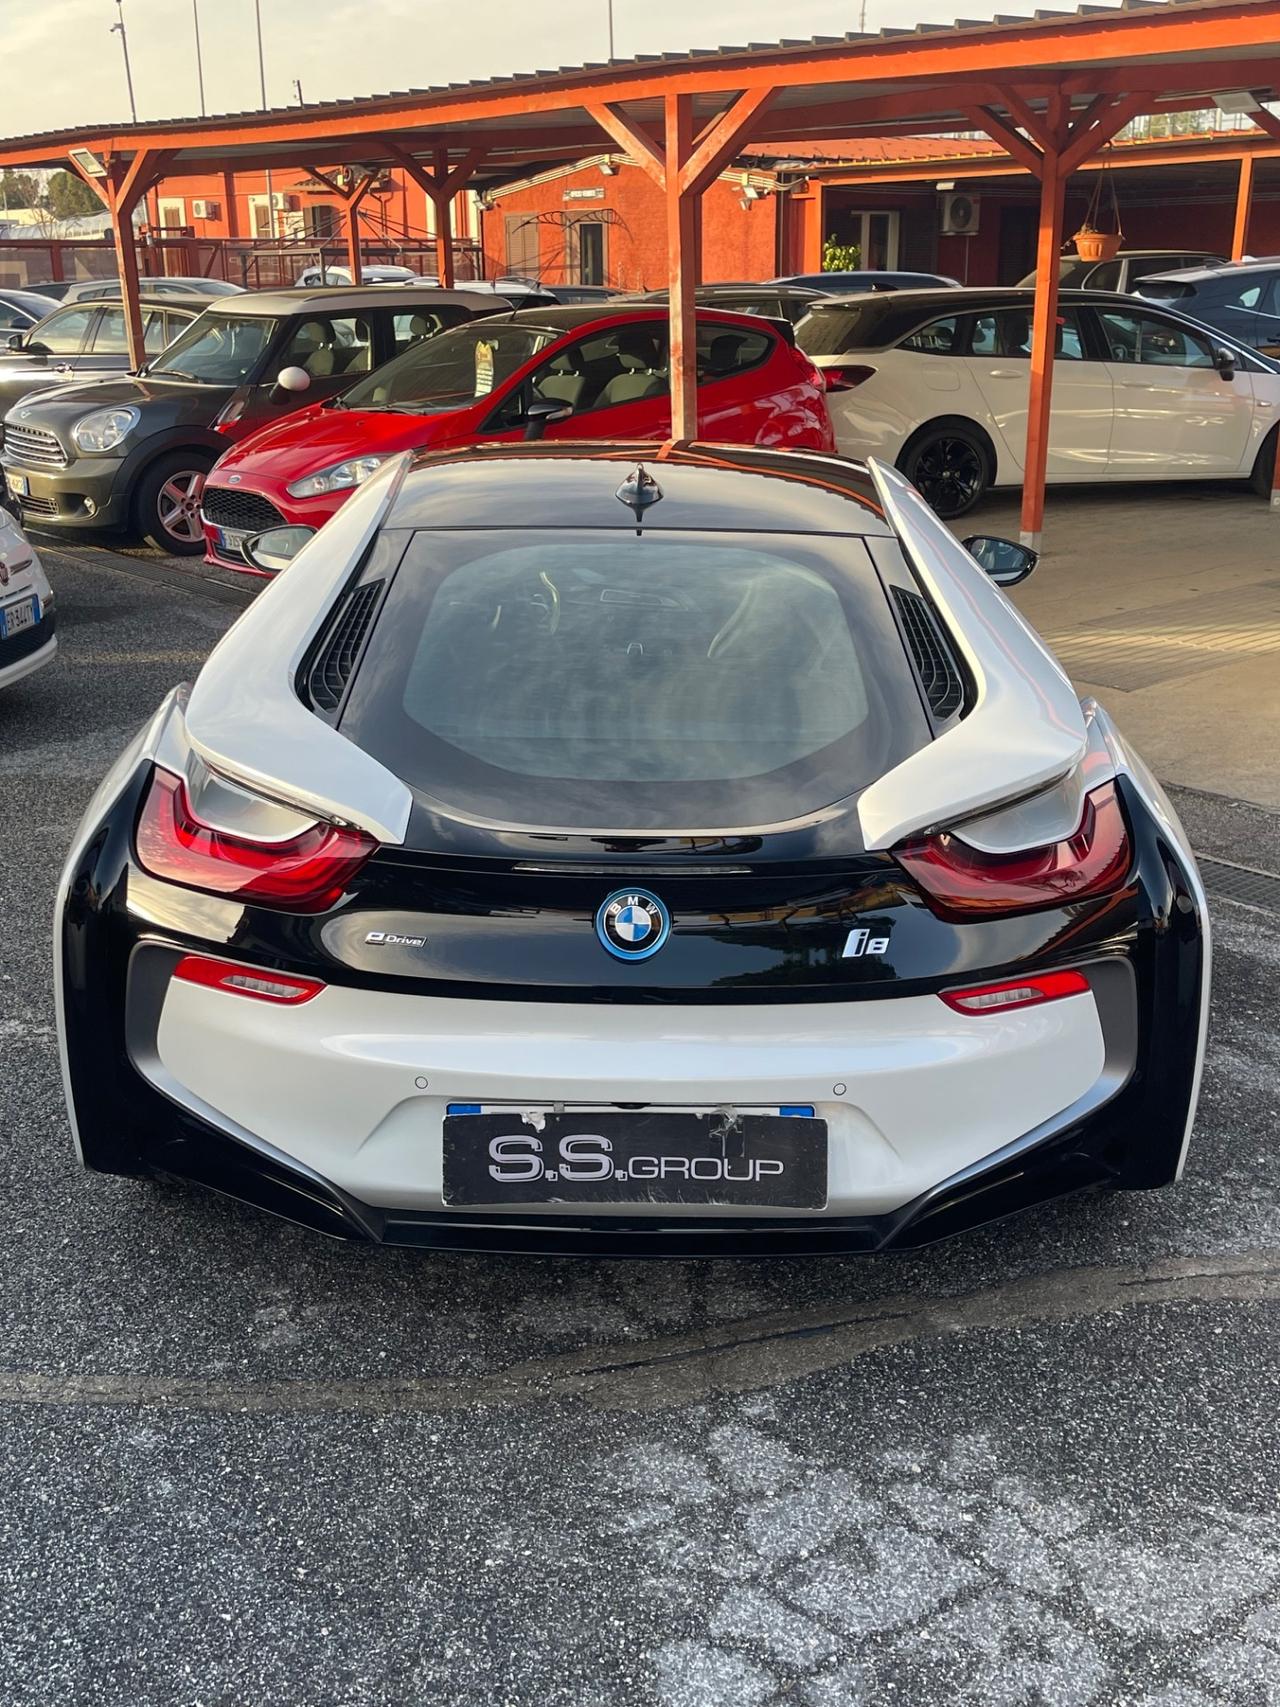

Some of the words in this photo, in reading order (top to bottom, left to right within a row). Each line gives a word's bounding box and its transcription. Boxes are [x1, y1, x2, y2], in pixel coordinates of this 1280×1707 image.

[609, 896, 658, 915] BMW
[842, 928, 890, 958] i8
[628, 1156, 784, 1182] GROUP
